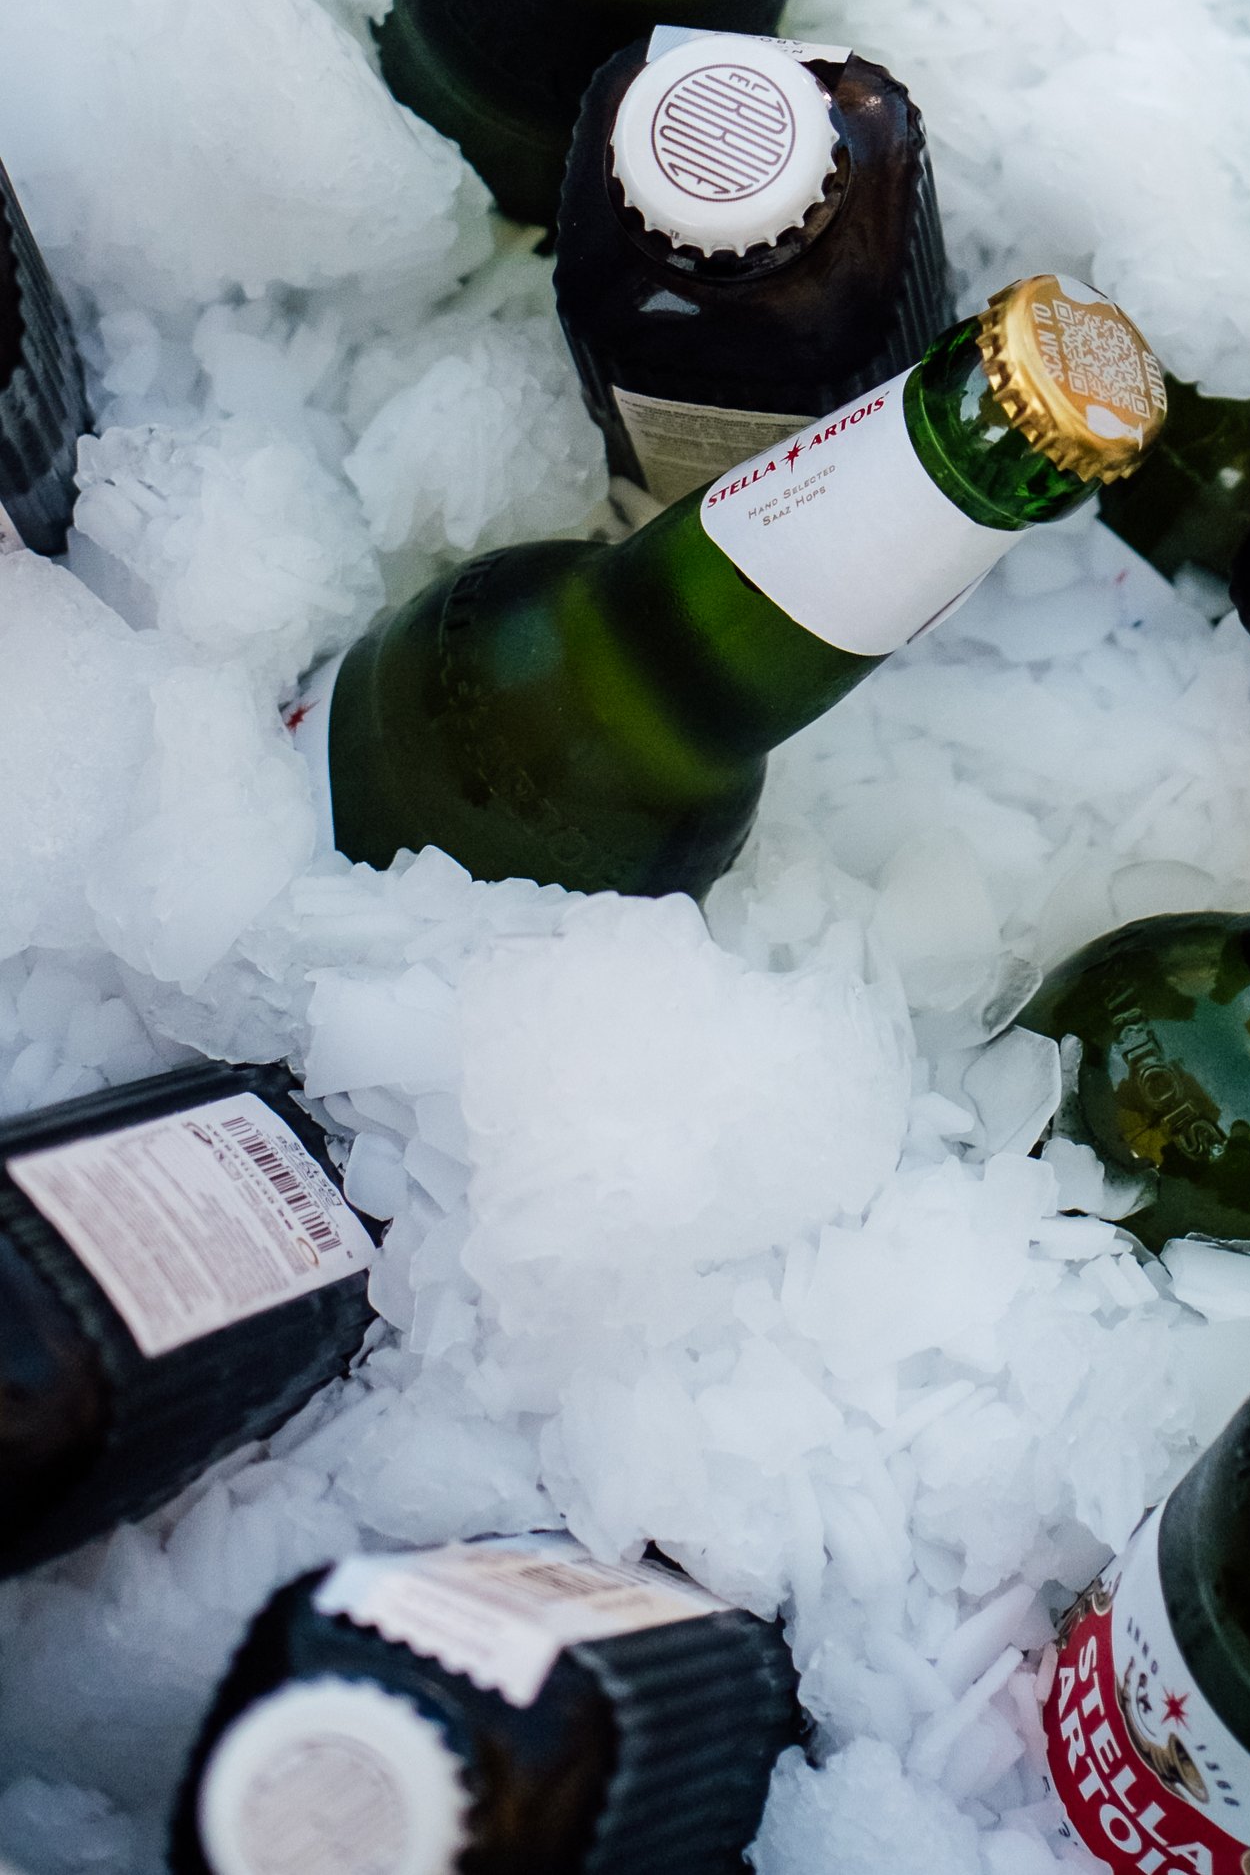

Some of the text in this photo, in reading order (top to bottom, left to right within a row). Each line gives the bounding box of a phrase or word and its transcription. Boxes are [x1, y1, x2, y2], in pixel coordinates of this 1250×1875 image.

[729, 72, 771, 94] EL
[1032, 302, 1065, 383] SCAN TO
[1142, 351, 1168, 412] ENTER
[706, 460, 777, 509] STELLA
[808, 395, 886, 450] ARTOIS
[748, 464, 837, 521] HAND SELECTED
[762, 486, 827, 527] SAAZ HOPS
[1058, 1666, 1198, 1875] ARTOI
[1078, 1635, 1214, 1875] STELLA
